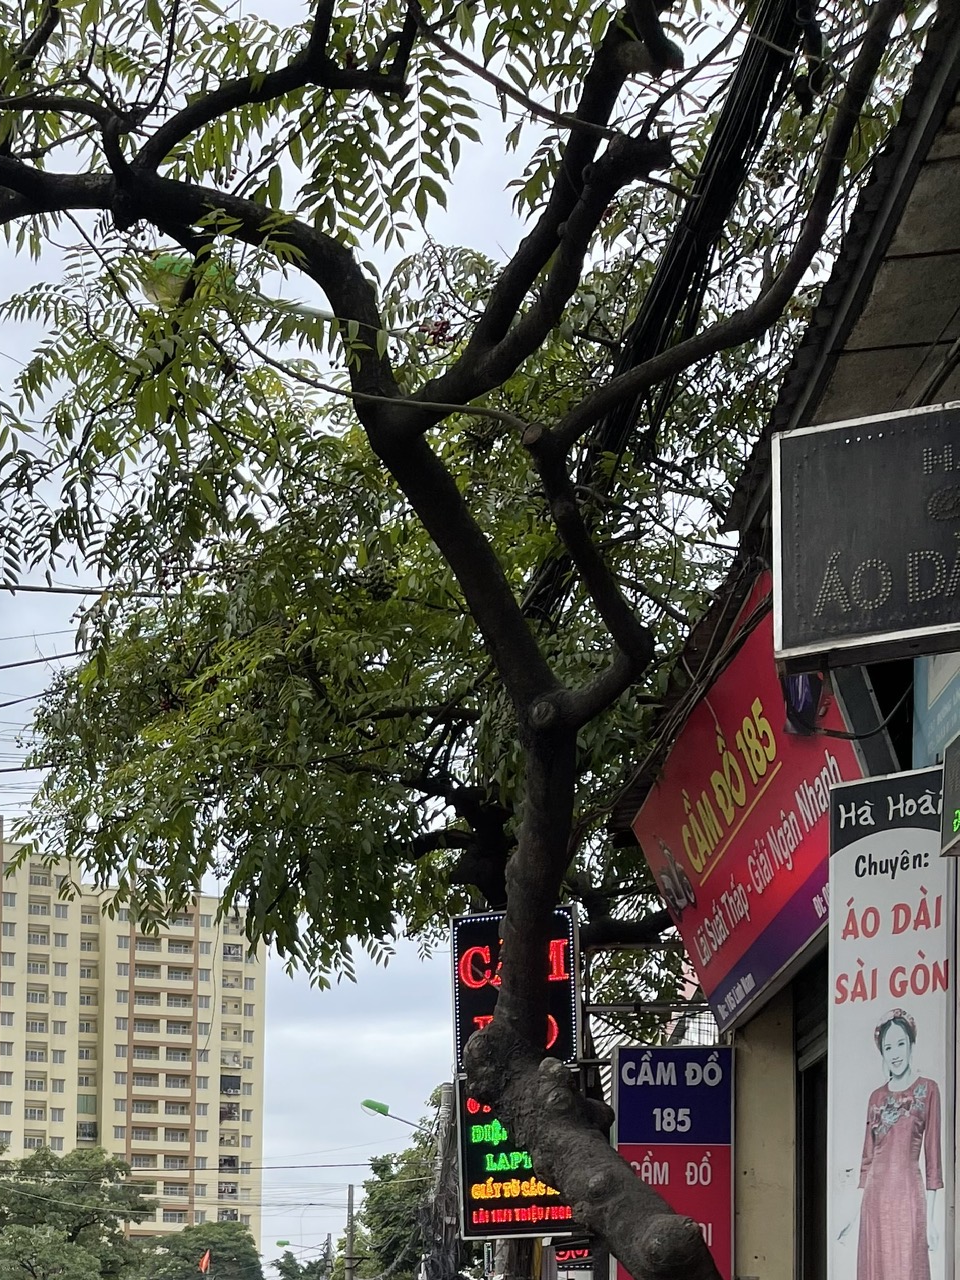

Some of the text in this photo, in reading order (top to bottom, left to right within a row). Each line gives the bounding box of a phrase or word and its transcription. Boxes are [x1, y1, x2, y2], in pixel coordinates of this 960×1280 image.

[681, 697, 777, 873] CẦM ĐỒ 185
[838, 799, 876, 829] Hà
[693, 925, 713, 967] Lãi
[704, 899, 730, 953] Suất
[720, 873, 751, 922] Thấp
[747, 839, 775, 894] Giải
[766, 809, 803, 871] Ngân
[795, 750, 842, 833] Nhanh
[854, 849, 930, 880] Chuyên:
[841, 885, 942, 941] ÁO DÀI
[834, 949, 950, 1005] SÀI GÒN
[621, 1050, 723, 1087] CẦM ĐỒ
[652, 1107, 692, 1133] 185
[630, 1151, 712, 1186] ẦM ĐỒ
